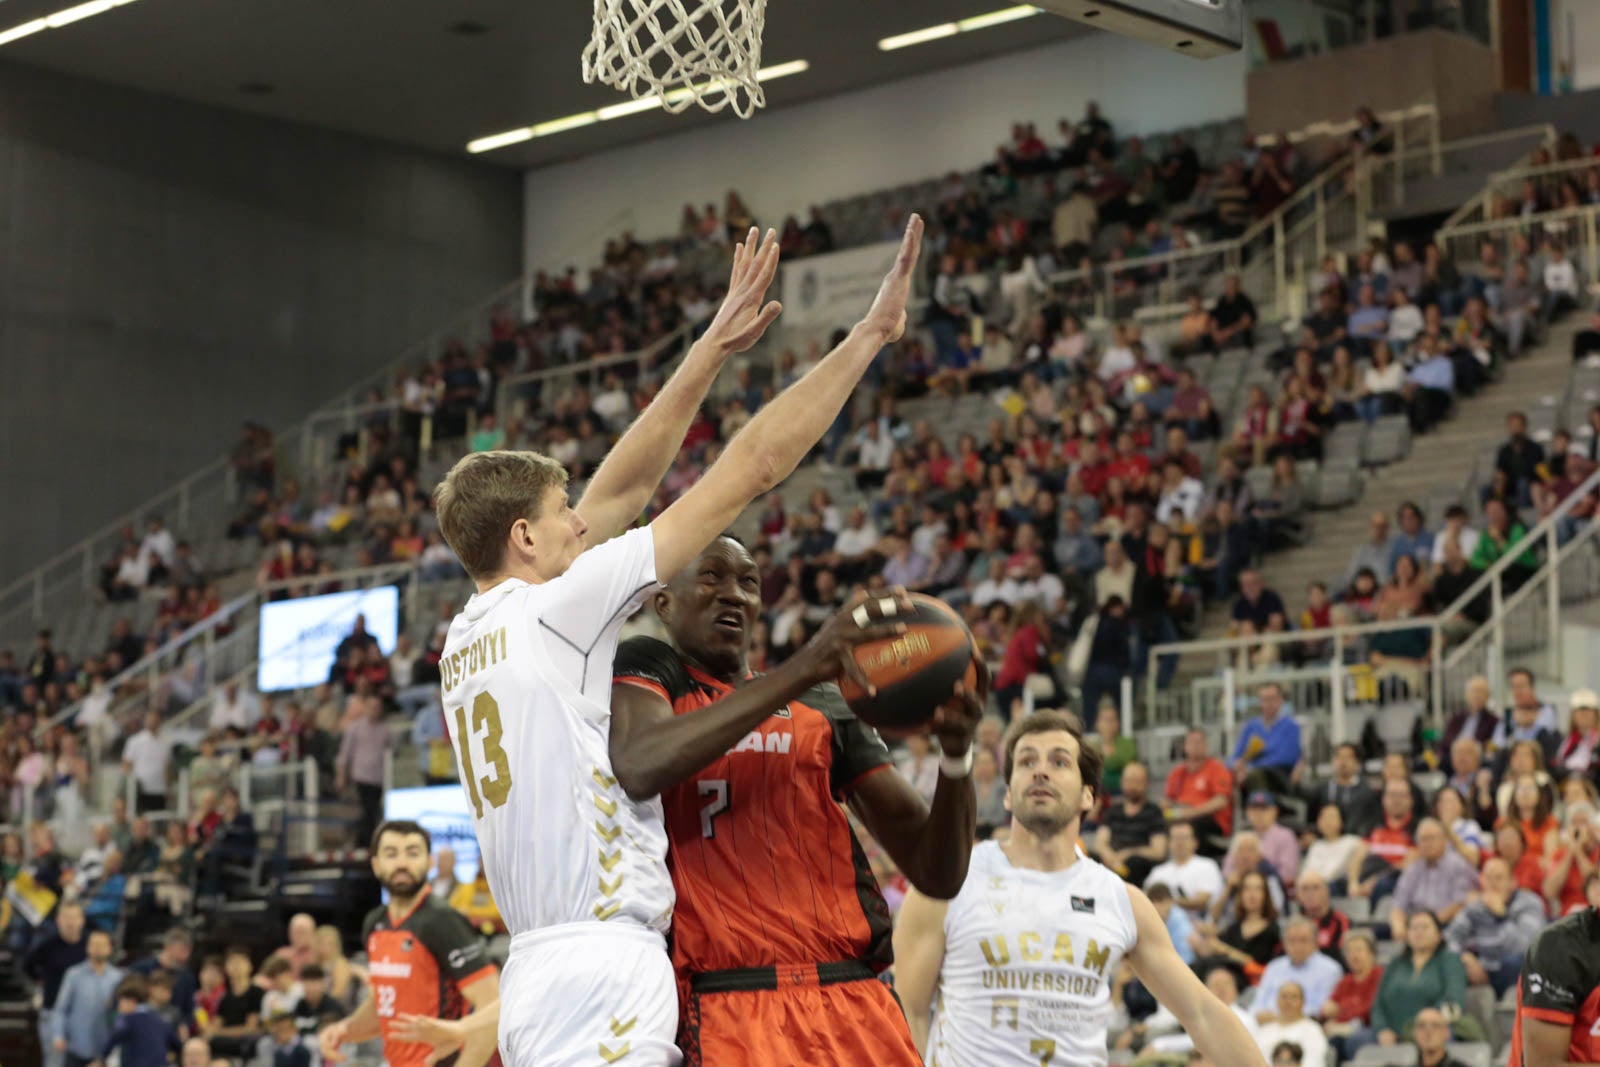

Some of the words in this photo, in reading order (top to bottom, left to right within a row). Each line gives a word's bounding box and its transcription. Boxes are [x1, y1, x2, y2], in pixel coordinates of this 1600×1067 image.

[455, 690, 512, 820] 13
[725, 731, 792, 754] AN
[697, 779, 729, 838] 7
[980, 931, 1110, 976] UCAM
